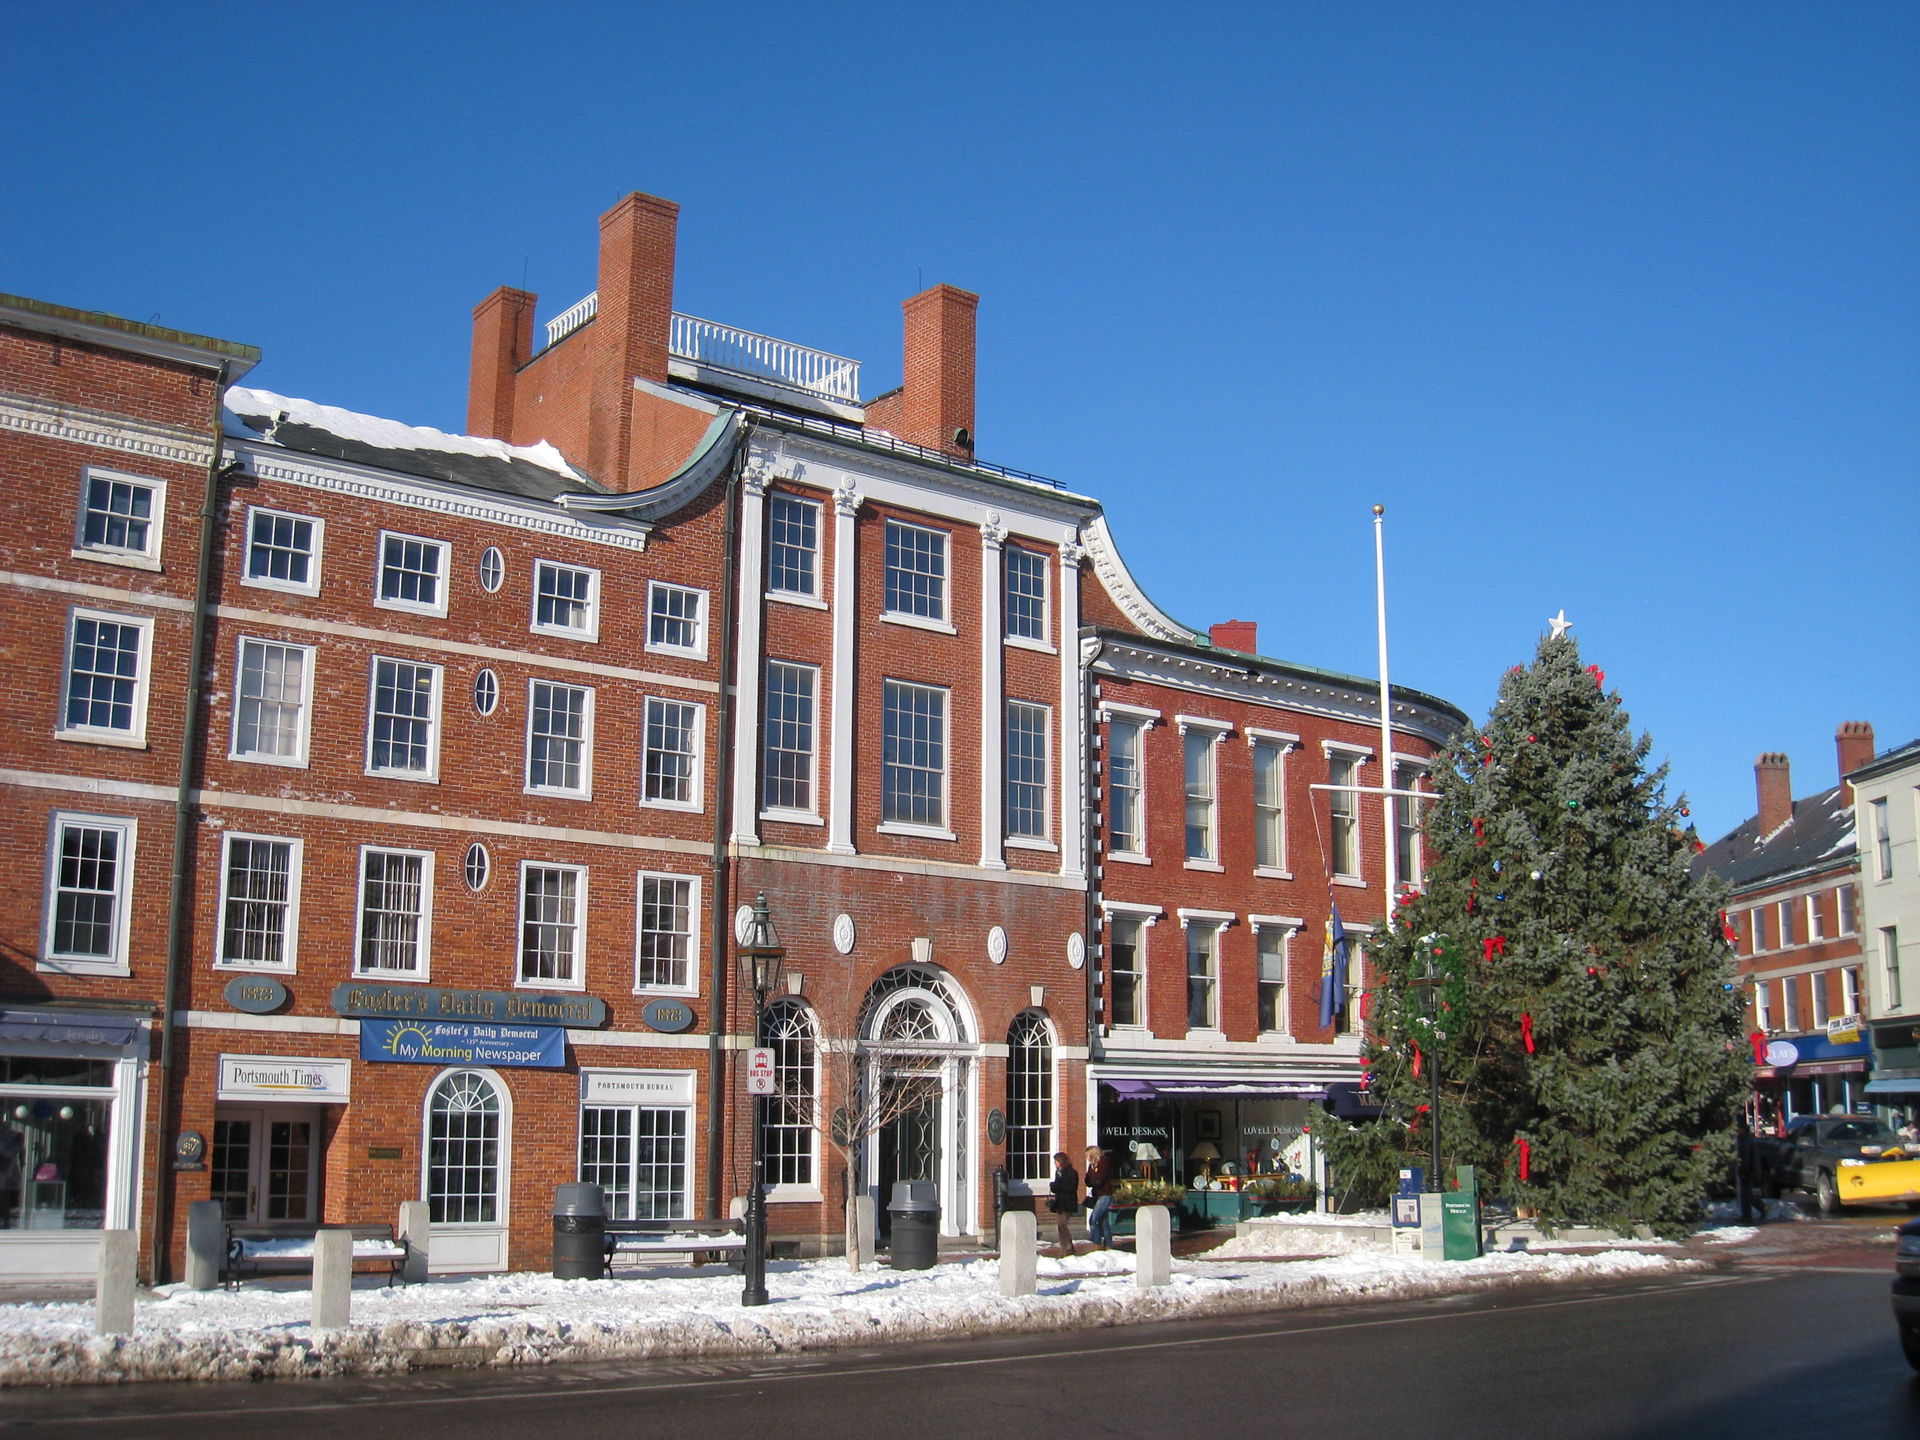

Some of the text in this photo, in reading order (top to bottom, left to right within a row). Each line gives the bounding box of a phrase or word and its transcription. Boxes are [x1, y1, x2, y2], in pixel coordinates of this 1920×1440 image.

[347, 987, 593, 1021] Foster's Daily Democrat
[434, 1025, 538, 1039] Foster's Daily Democrat
[480, 1040, 510, 1048] Anniversary
[400, 1043, 541, 1063] My Morning Newspaper
[233, 1067, 322, 1086] Portsmouth Times
[597, 1082, 674, 1091] PORTSMOUTH BUREAU
[1103, 1127, 1166, 1136] OVELL DESIGNS
[1243, 1126, 1271, 1134] LOVELL
